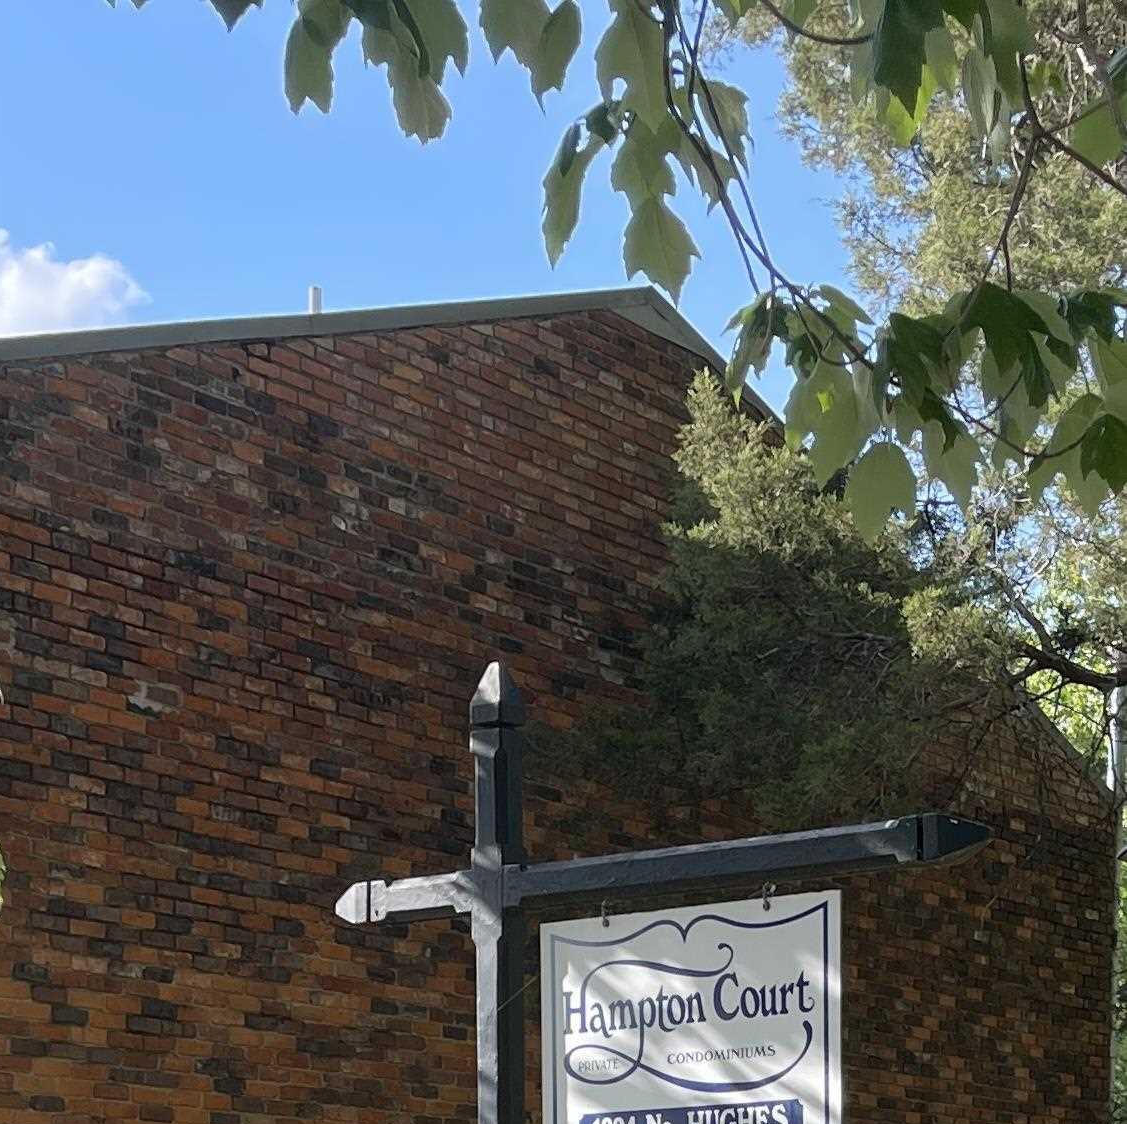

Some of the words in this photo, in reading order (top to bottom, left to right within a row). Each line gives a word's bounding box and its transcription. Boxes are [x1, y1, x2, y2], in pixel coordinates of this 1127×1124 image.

[563, 983, 706, 1039] Hampton
[713, 970, 815, 1021] Court
[578, 1058, 619, 1073] PRIVATE
[667, 1044, 776, 1065] CONDOMINIUMS
